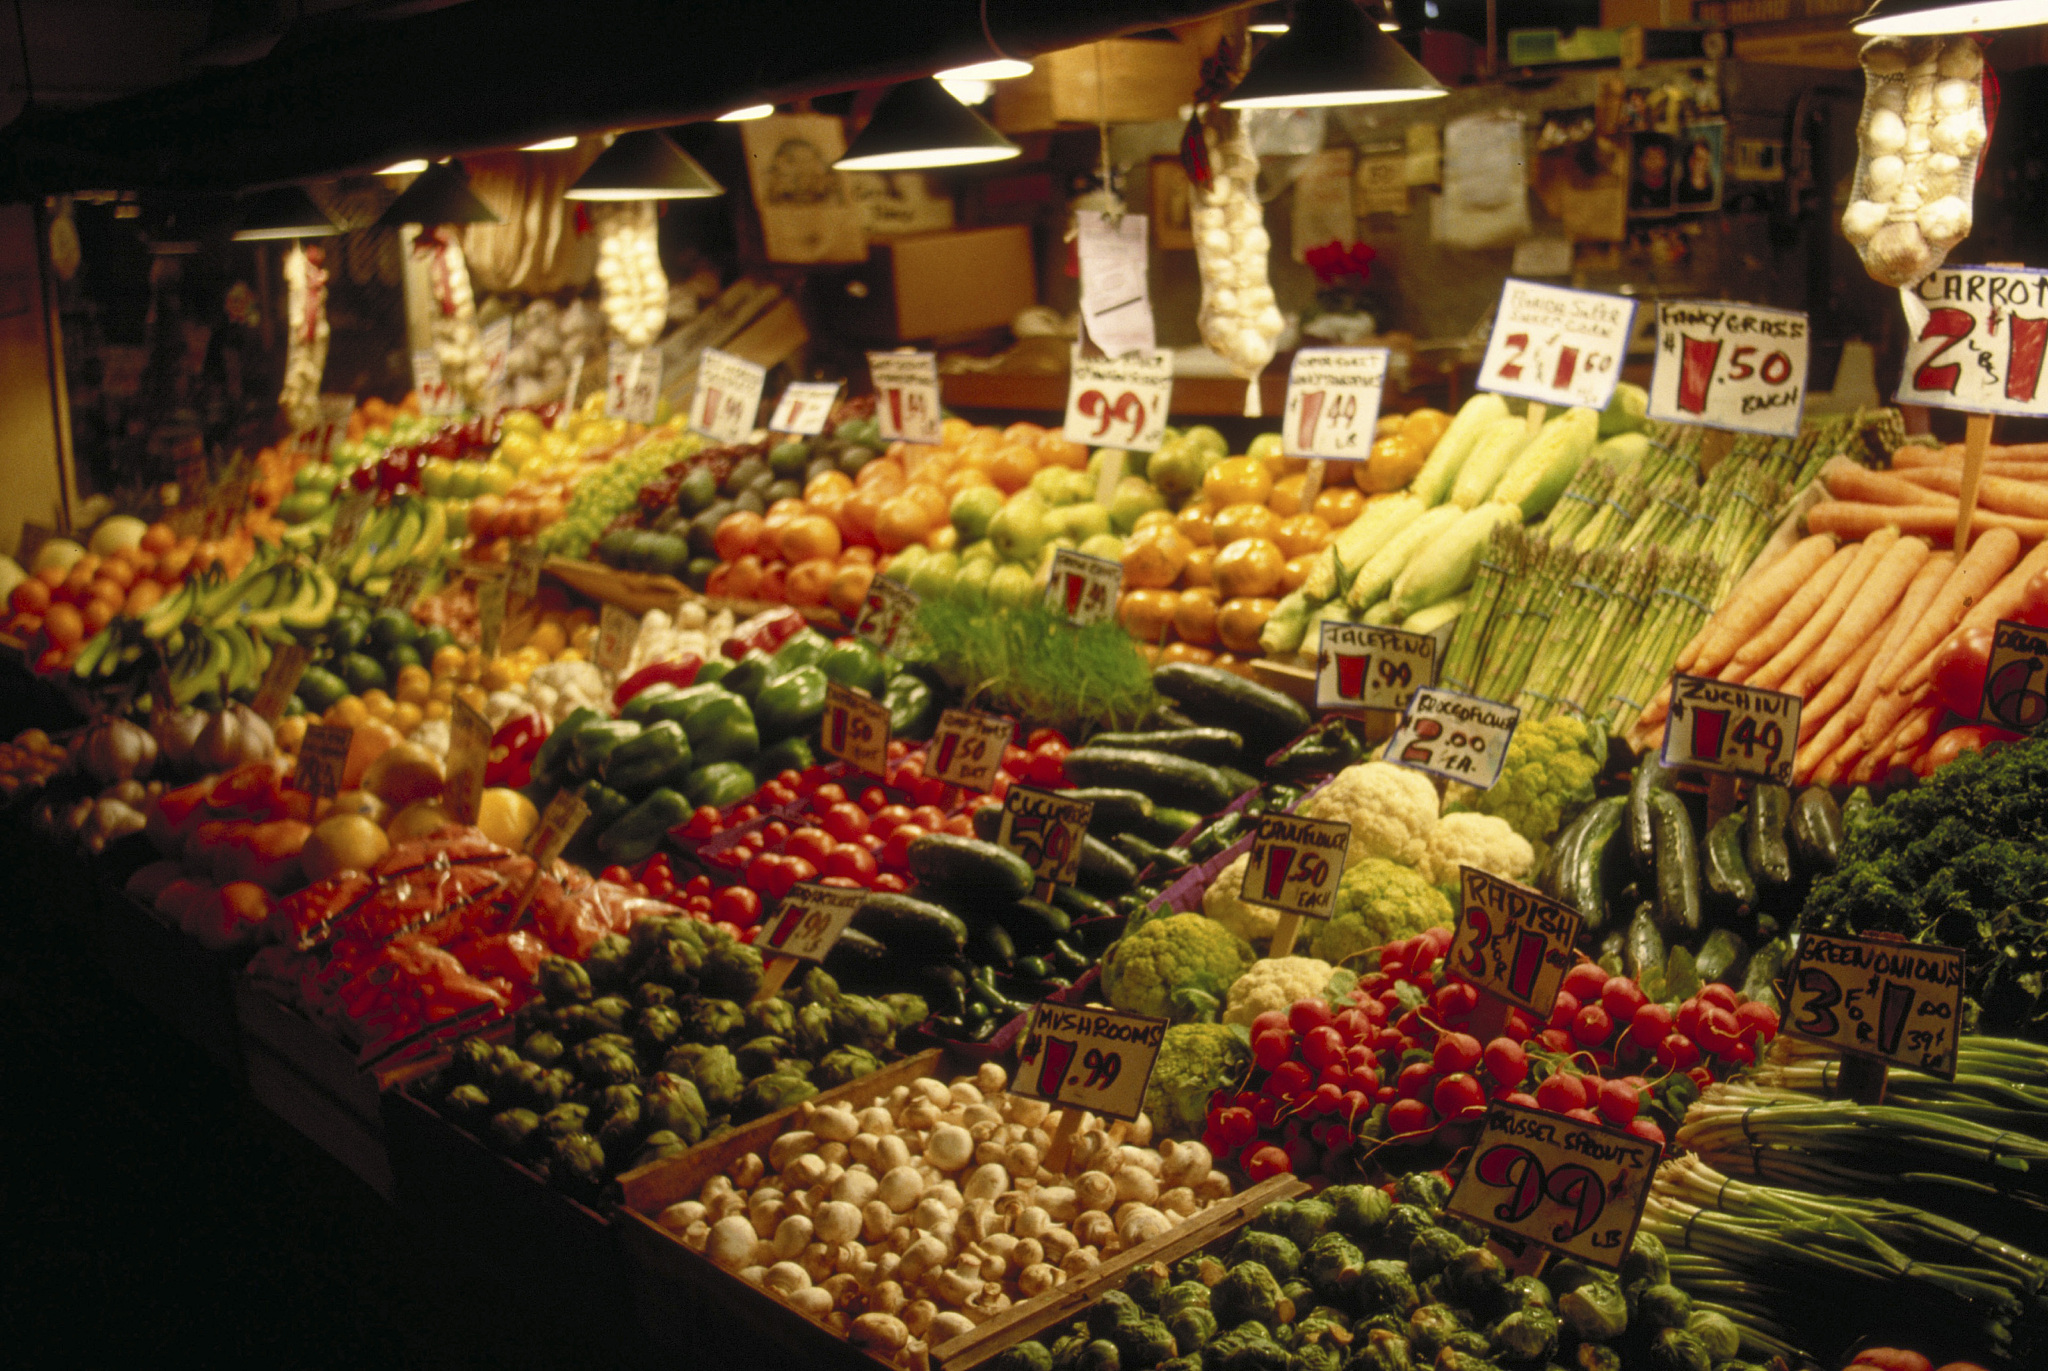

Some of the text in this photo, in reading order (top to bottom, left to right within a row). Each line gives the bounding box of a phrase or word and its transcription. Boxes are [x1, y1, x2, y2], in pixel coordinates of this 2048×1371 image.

[1497, 332, 1529, 380] 2
[1726, 313, 1804, 340] GRASS
[1913, 306, 1977, 396] 2
[1680, 681, 1790, 718] ZUCHINI
[1467, 874, 1574, 948] RADISH
[1458, 906, 1493, 978] 3
[1800, 937, 1960, 989] GREEN ONIONS
[1795, 966, 1843, 1038] 3
[1489, 1109, 1646, 1170] BRUSSEL SPROUTS
